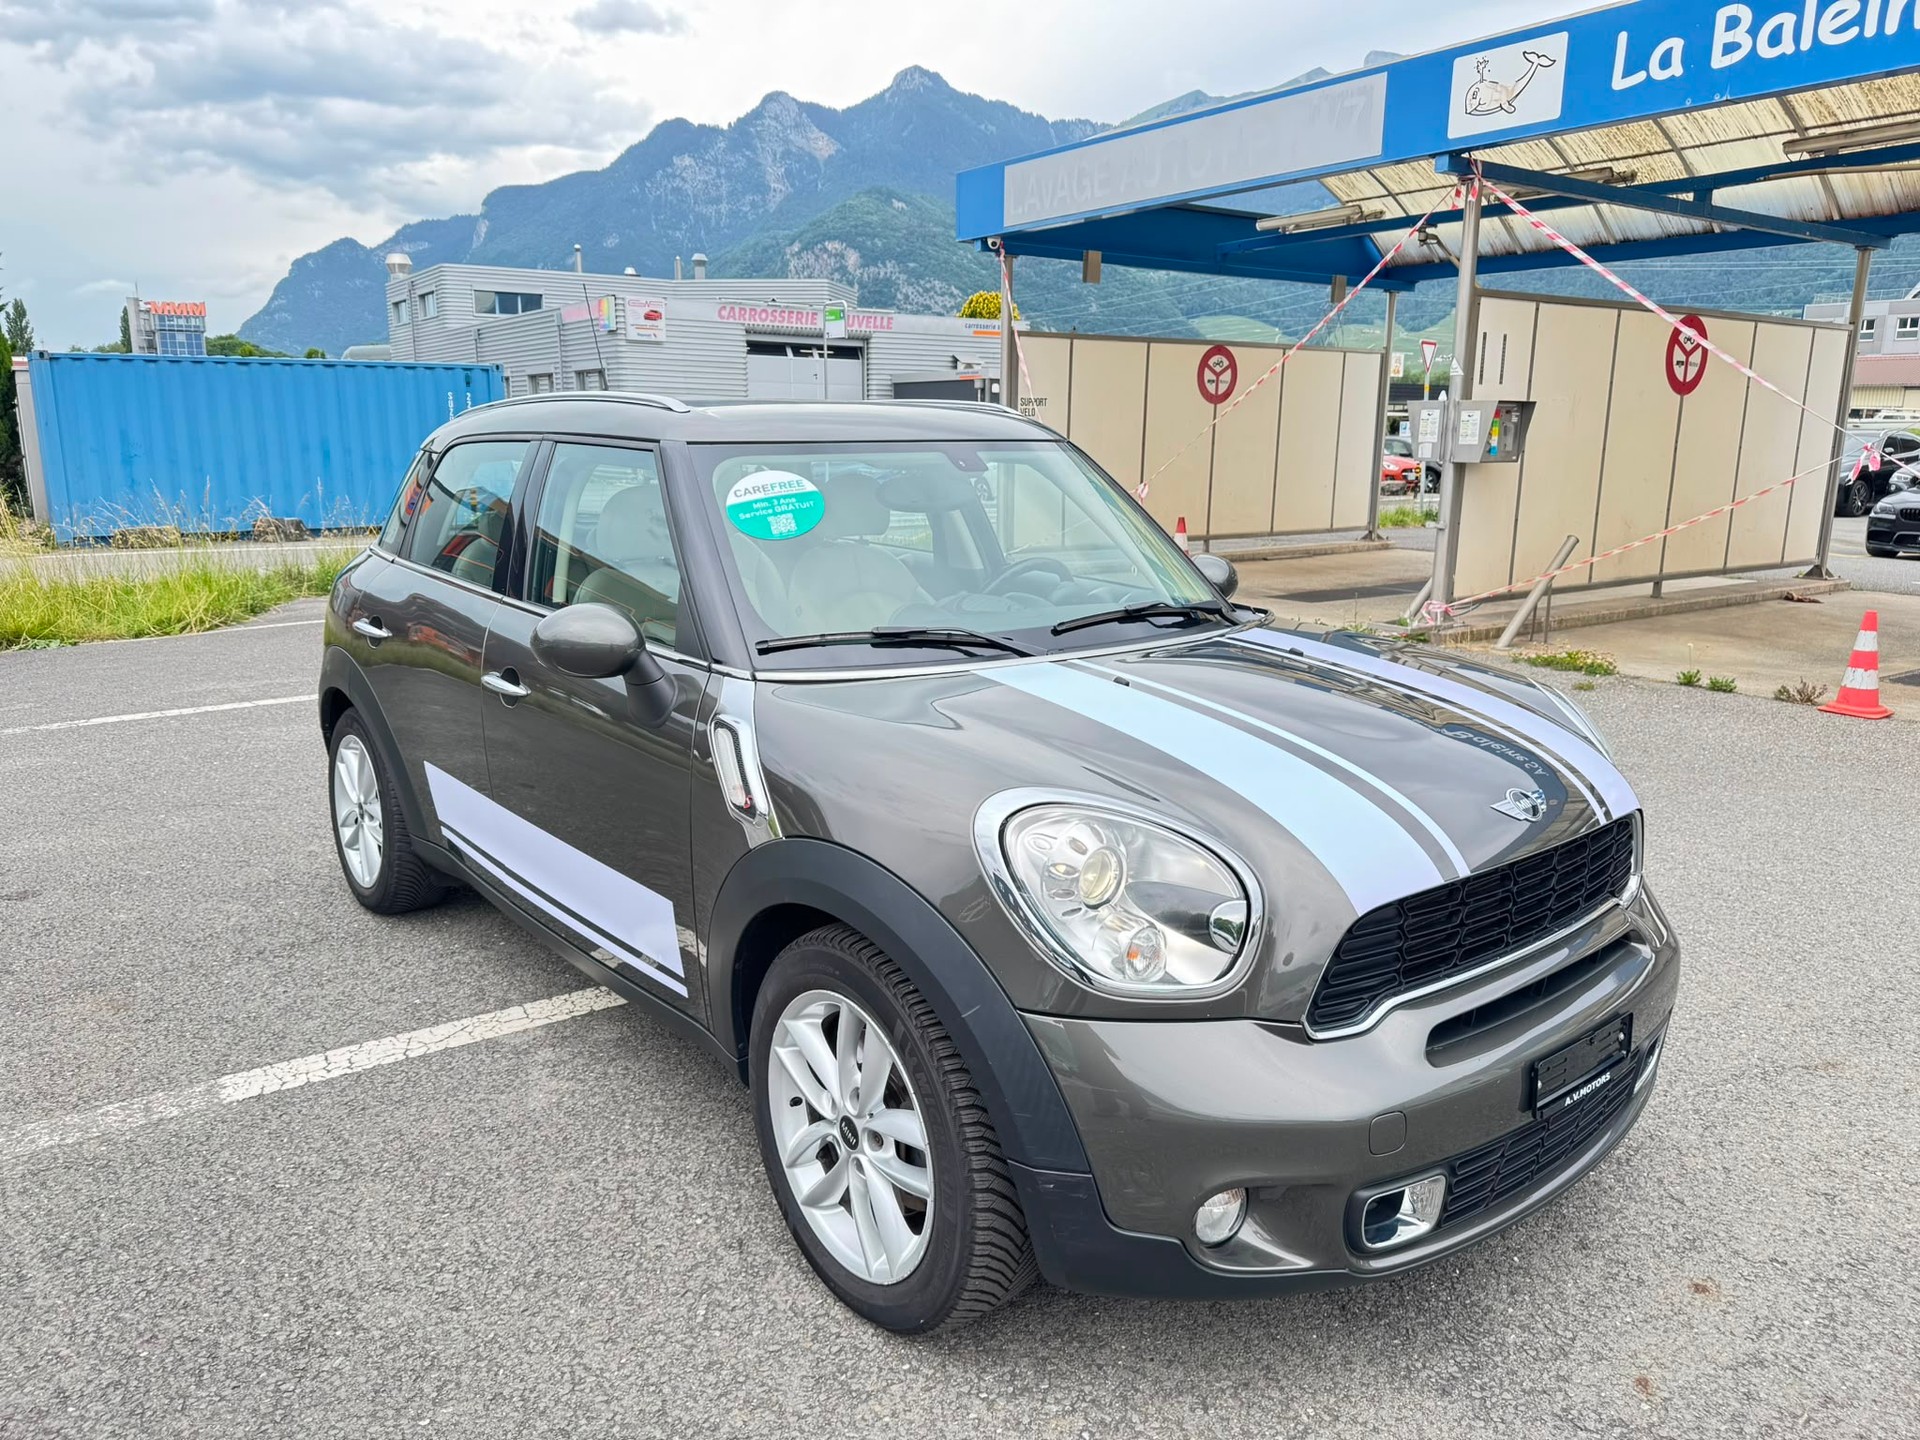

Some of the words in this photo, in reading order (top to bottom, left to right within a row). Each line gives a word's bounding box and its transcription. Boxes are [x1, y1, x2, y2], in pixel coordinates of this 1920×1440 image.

[1611, 30, 1685, 91] La
[148, 300, 206, 318] MMM
[717, 304, 819, 327] CARROSSERIE
[847, 313, 894, 331] UVELLE
[964, 321, 997, 330] carrosserie
[733, 479, 806, 498] CAREFREE
[738, 507, 773, 521] Service
[774, 500, 815, 513] GRATUIT
[841, 1120, 857, 1146] MINI
